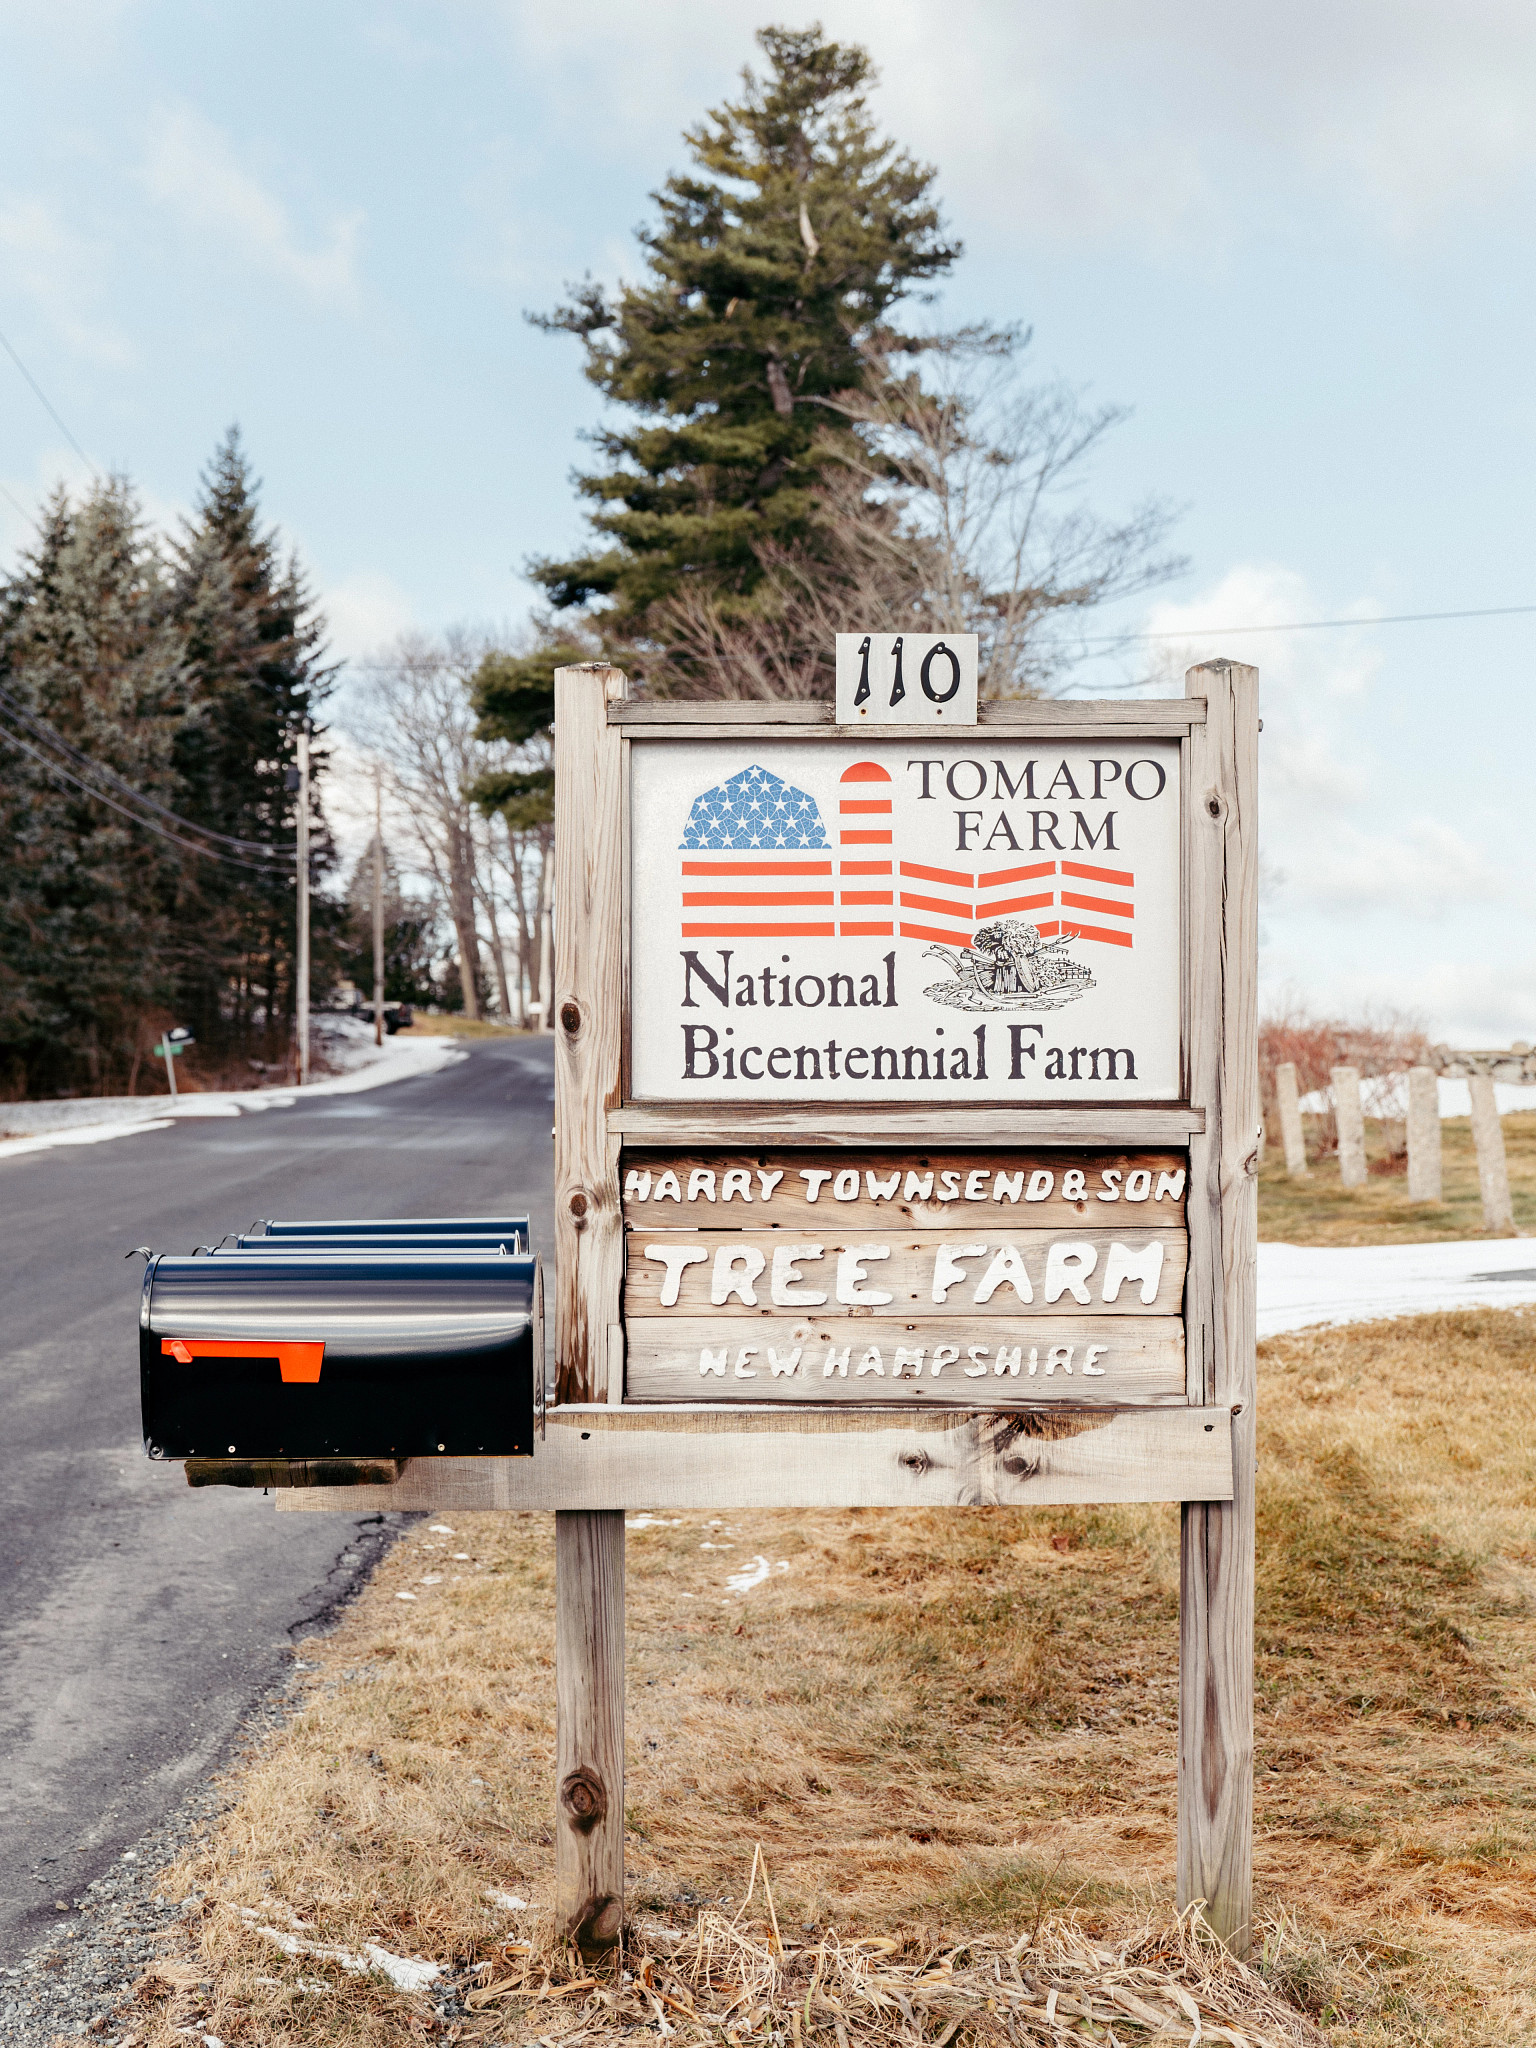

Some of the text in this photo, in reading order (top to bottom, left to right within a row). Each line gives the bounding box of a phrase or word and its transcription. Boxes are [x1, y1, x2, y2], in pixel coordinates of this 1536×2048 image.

[853, 636, 961, 707] 110
[906, 760, 1167, 801] TOMAPO
[955, 811, 1120, 851] FARM
[681, 951, 898, 1008] National
[681, 1025, 1138, 1081] Bicentennial Farm
[623, 1168, 784, 1203] HARRY
[644, 1241, 1164, 1307] TREE FARM
[699, 1345, 1108, 1379] NEW HAMPSHIRE
